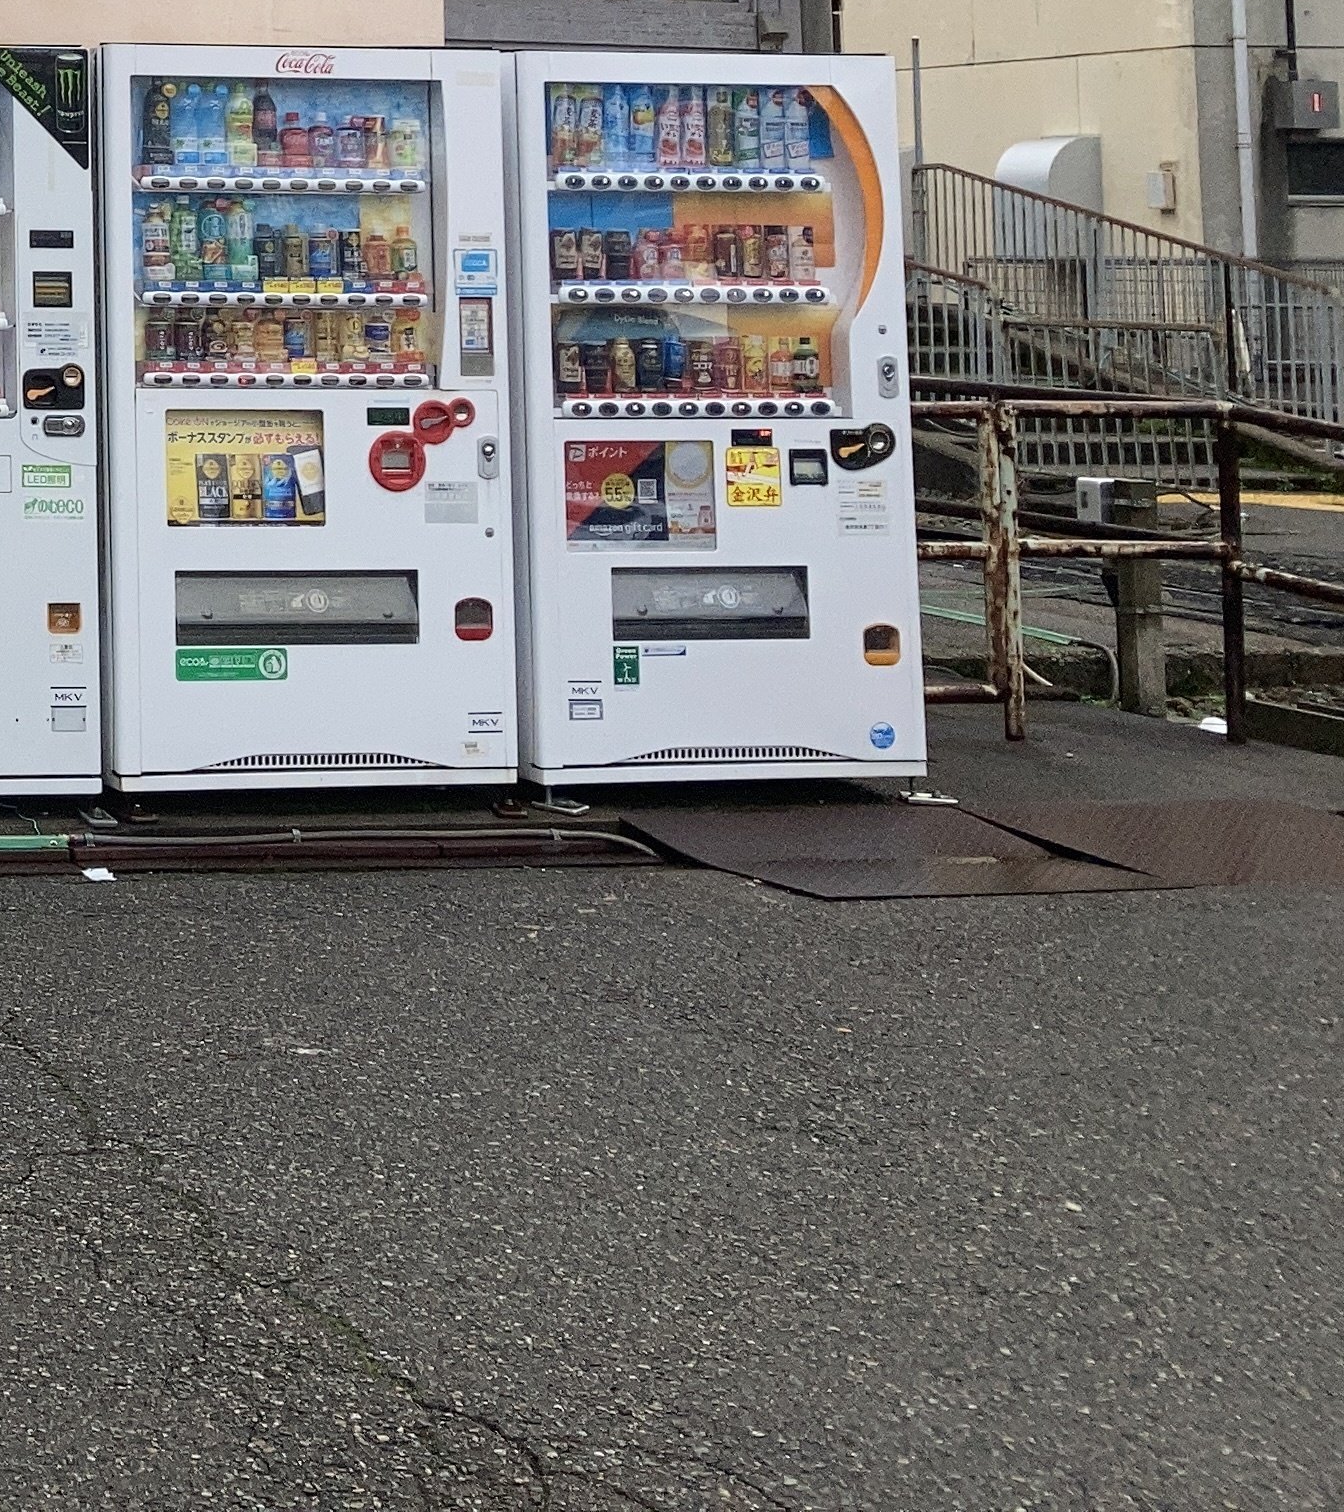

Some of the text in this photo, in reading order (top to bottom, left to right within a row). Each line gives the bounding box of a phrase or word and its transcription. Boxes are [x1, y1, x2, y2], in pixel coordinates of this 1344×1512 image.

[0, 50, 47, 100] Unleash
[588, 446, 627, 458] ポイント
[732, 486, 779, 503] 金沢弁
[624, 521, 642, 534] gift
[643, 523, 662, 532] card
